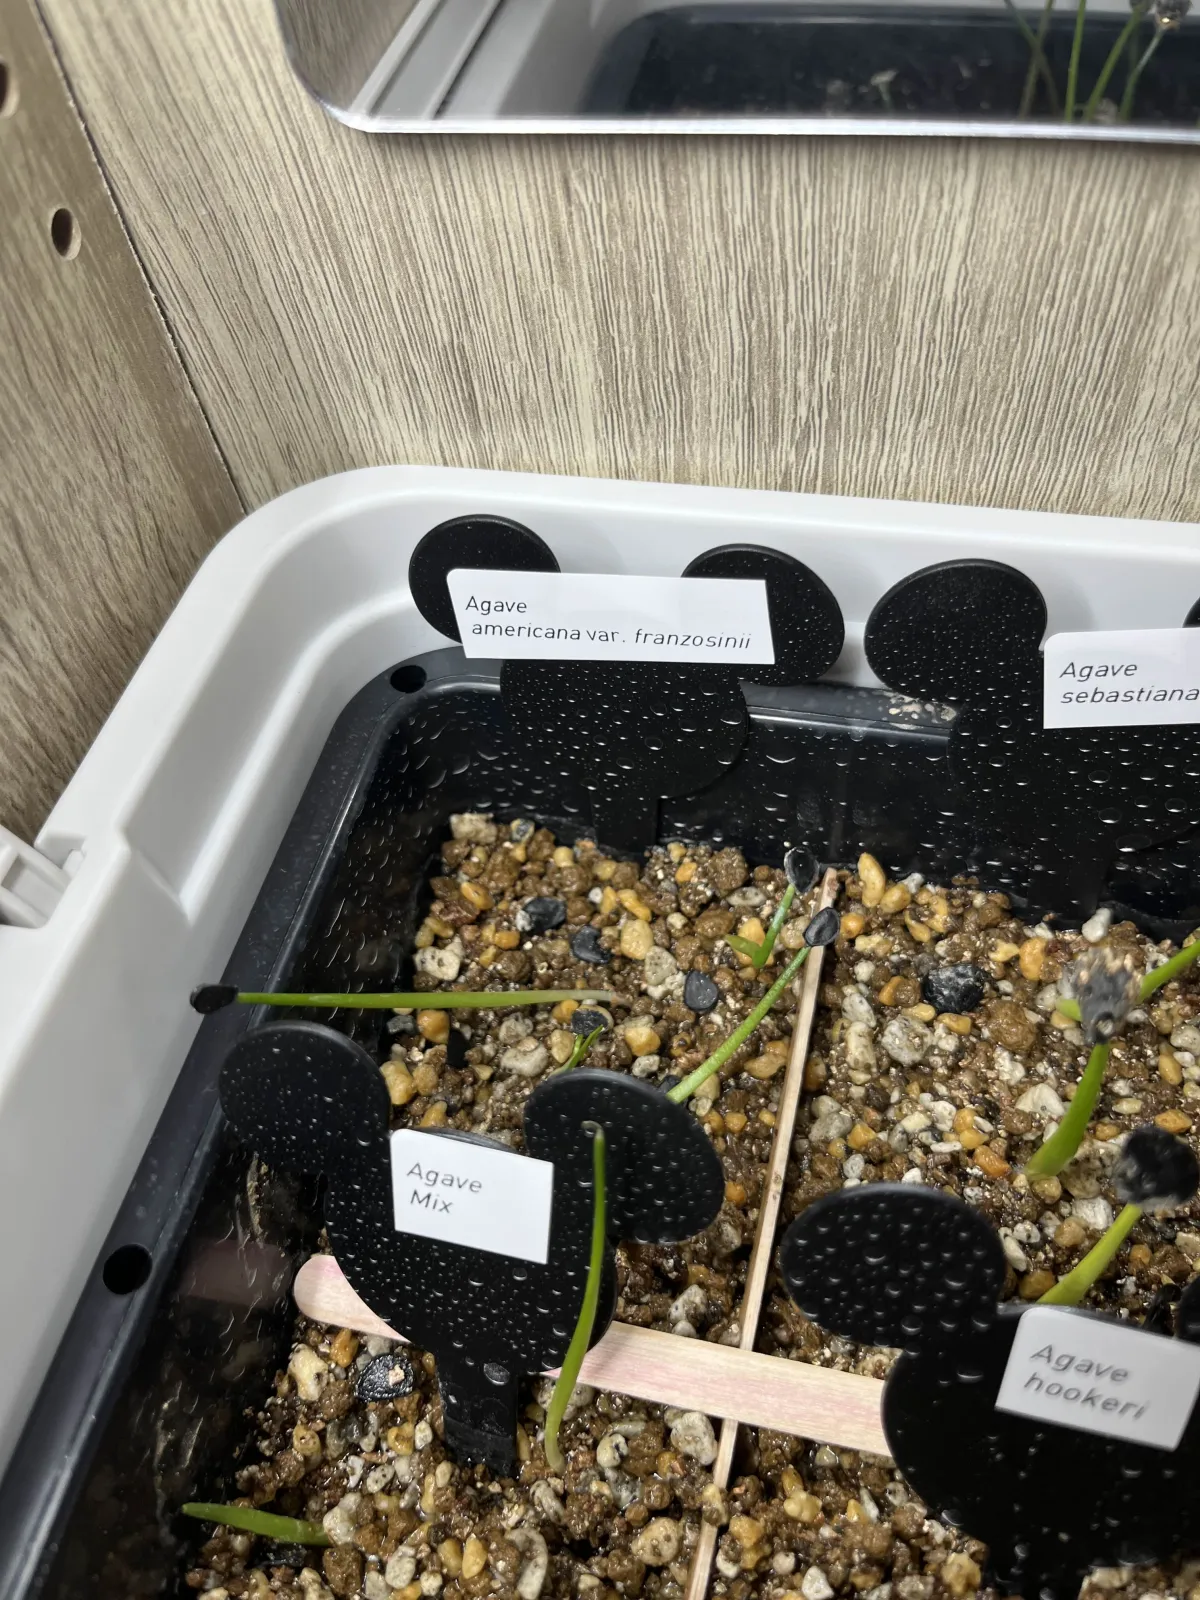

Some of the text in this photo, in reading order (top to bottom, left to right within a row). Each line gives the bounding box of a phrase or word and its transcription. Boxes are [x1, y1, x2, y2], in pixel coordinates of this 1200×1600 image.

[465, 595, 527, 615] Agave
[472, 621, 752, 649] americana var. franzosinii
[1059, 662, 1138, 682] Agave
[1060, 685, 1200, 704] sebastiana
[406, 1162, 483, 1193] Agave
[410, 1189, 454, 1214] Mix
[1030, 1344, 1129, 1382] Agave
[1023, 1371, 1150, 1421] hookeri
